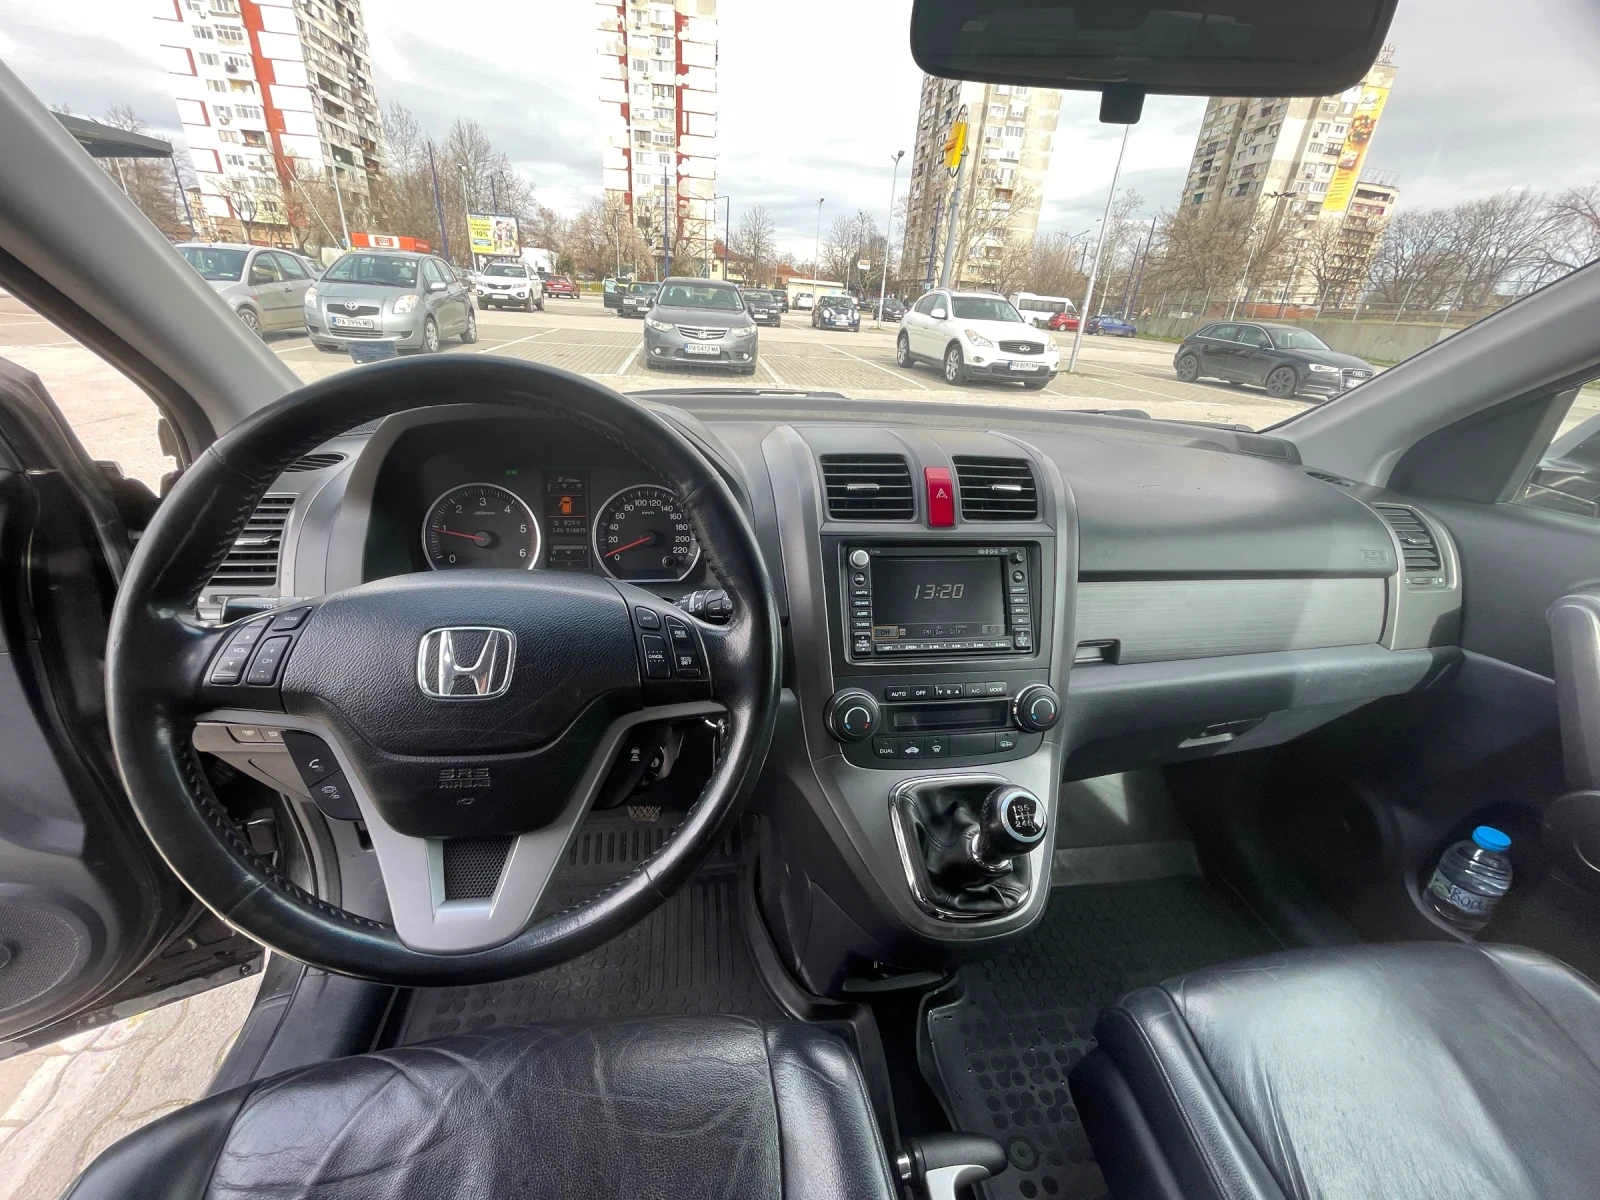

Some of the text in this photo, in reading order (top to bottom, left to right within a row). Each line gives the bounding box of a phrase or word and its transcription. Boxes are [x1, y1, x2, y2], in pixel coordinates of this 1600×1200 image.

[480, 498, 487, 506] 3
[456, 505, 463, 514] 2
[504, 505, 511, 514] 4
[520, 525, 527, 533] 5
[519, 549, 526, 557] 6
[449, 555, 456, 563] 0
[915, 584, 964, 599] 13:20
